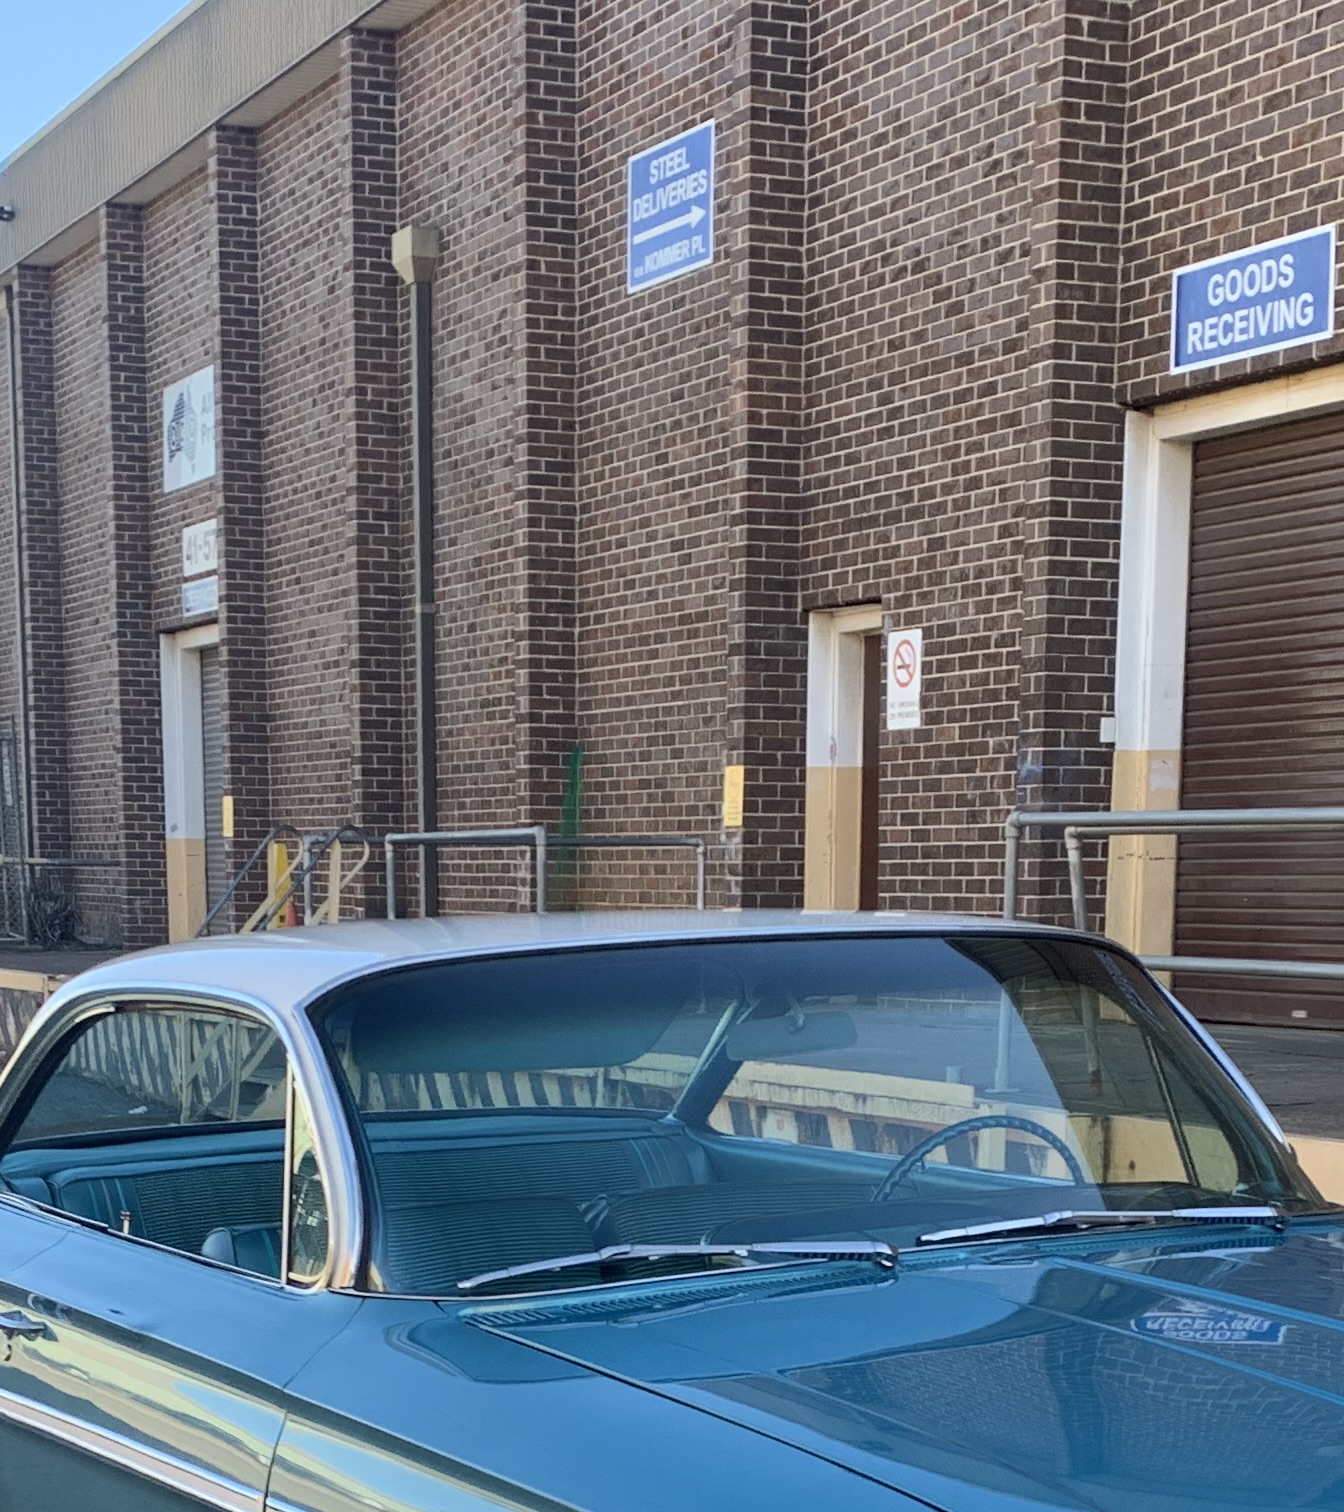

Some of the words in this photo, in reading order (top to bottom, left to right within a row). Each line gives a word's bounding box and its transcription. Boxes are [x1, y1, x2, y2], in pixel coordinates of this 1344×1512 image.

[650, 147, 690, 184] STEEL
[633, 169, 708, 222] DELIVERIES
[691, 234, 706, 254] PL
[1208, 254, 1295, 307] GOODS
[1187, 292, 1314, 354] RECEIVING
